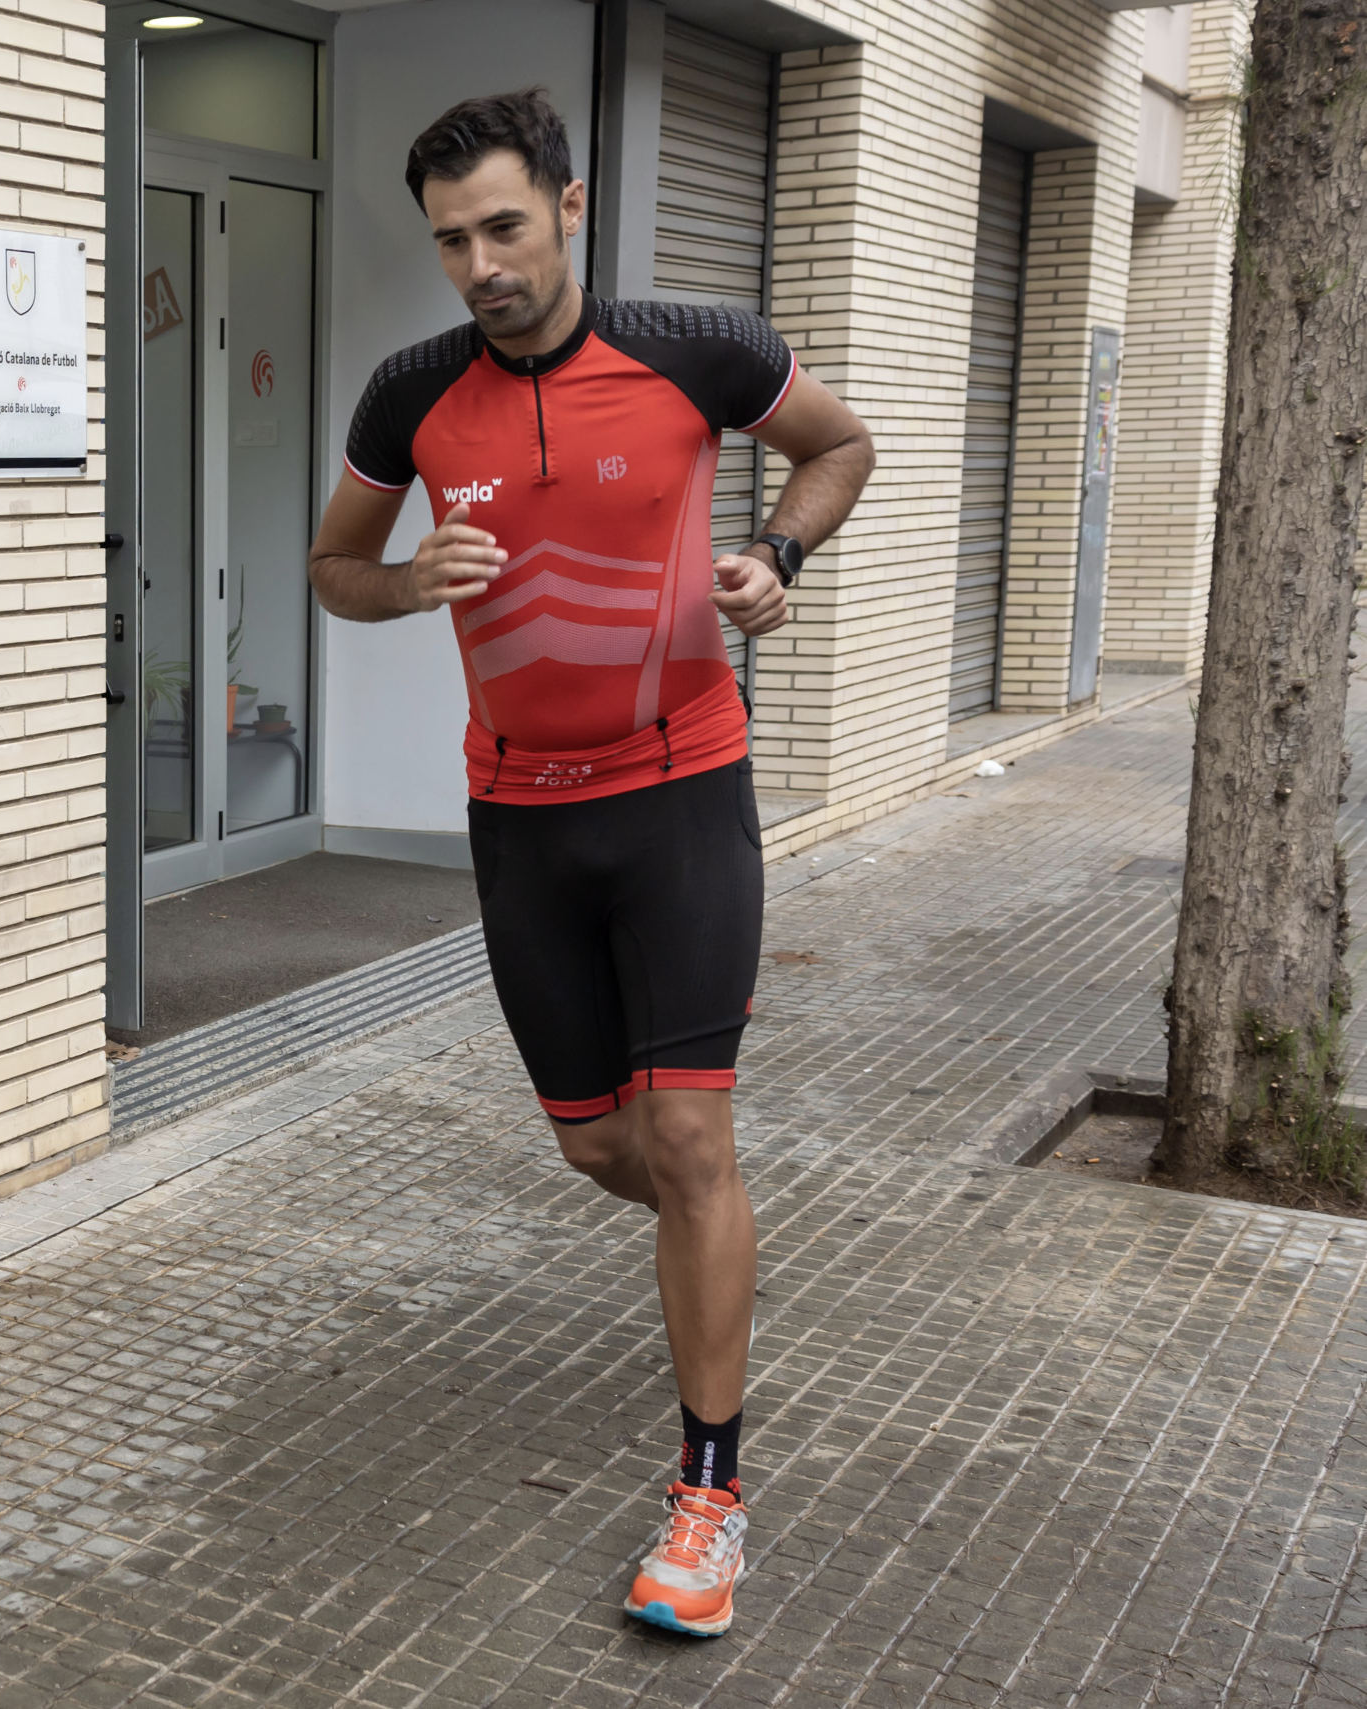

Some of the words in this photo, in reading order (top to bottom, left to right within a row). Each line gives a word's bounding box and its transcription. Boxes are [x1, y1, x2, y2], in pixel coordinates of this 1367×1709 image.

[5, 351, 40, 365] Catalana
[41, 353, 51, 366] de
[53, 354, 78, 367] Futbol
[15, 403, 29, 413] Baix
[30, 403, 61, 416] Llobregat
